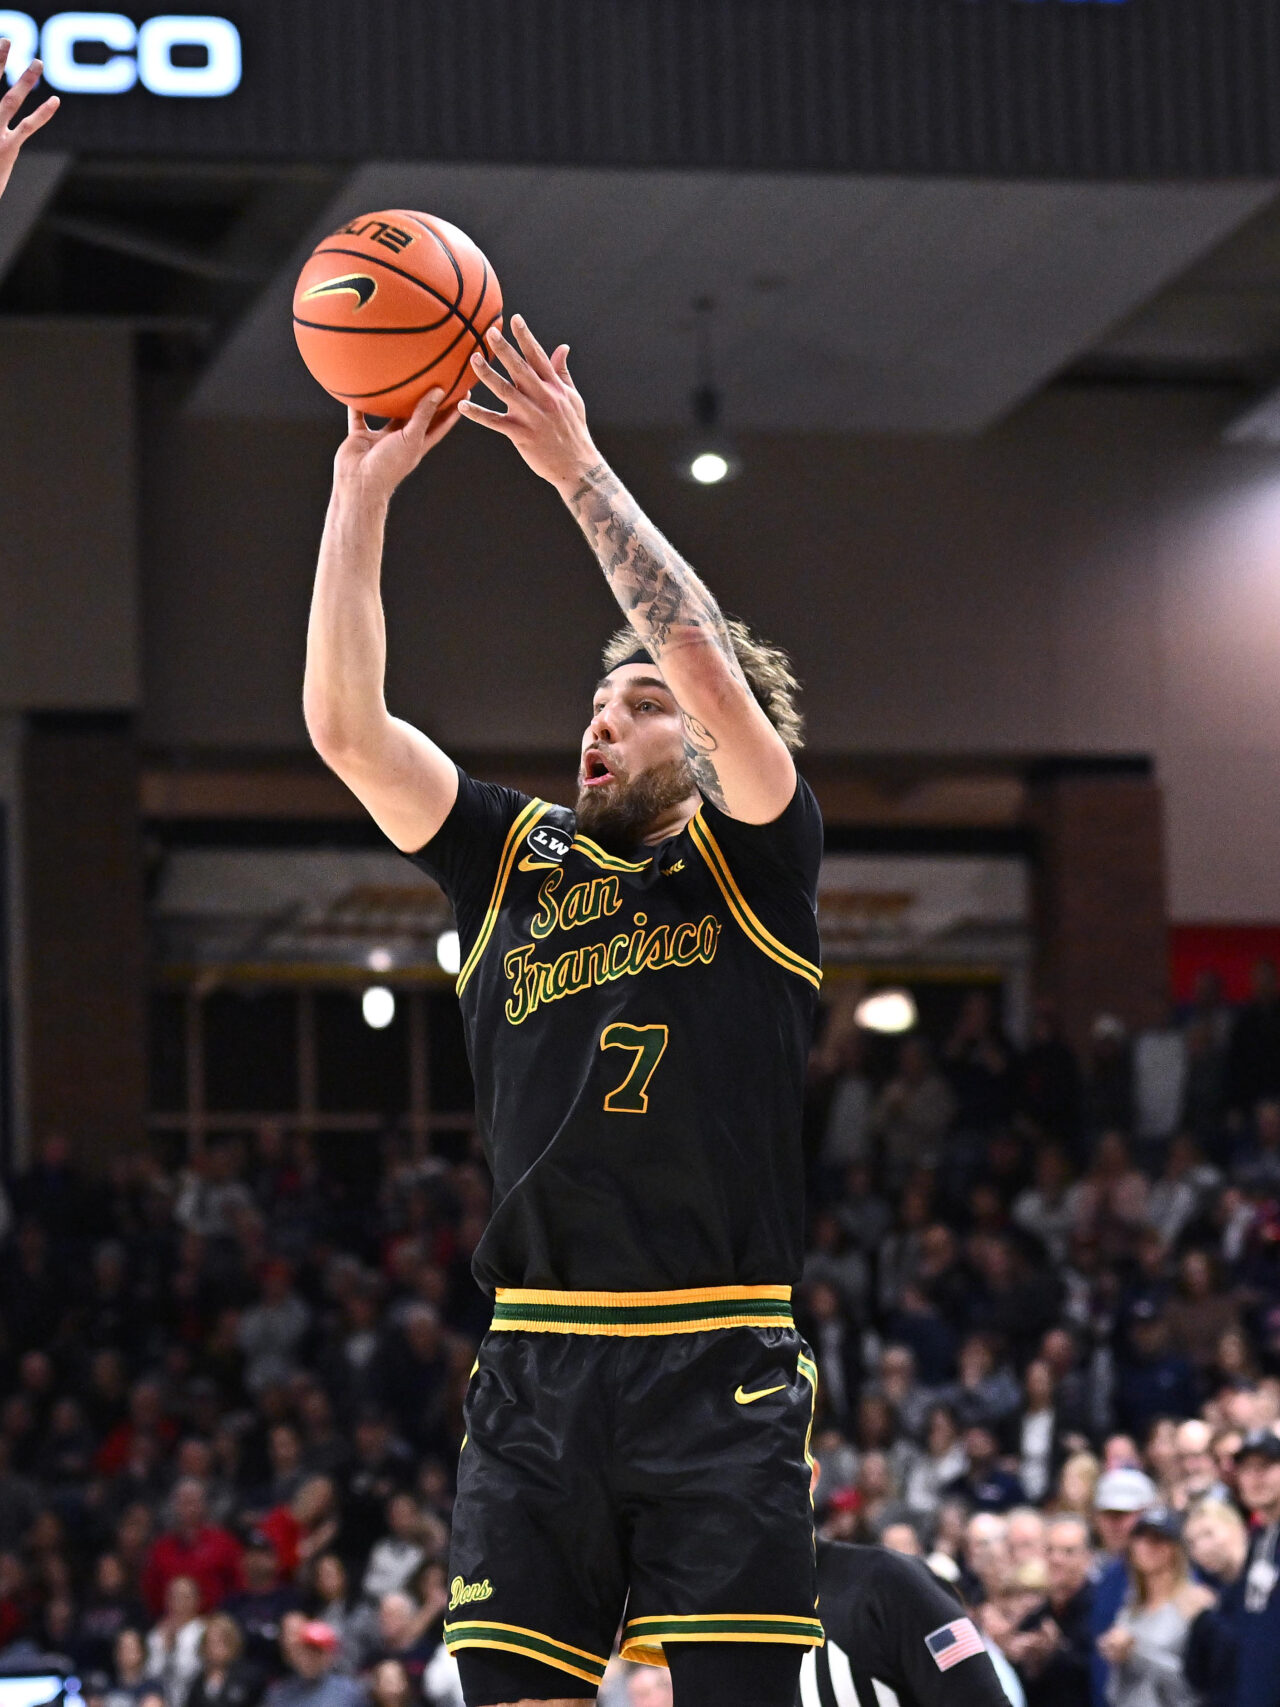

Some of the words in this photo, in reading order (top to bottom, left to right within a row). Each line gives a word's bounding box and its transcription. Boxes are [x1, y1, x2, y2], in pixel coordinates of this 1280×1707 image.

[532, 830, 570, 856] LW
[530, 868, 623, 939] San
[504, 912, 722, 1025] Francisco
[600, 1022, 669, 1113] 7
[448, 1575, 493, 1611] Dons
